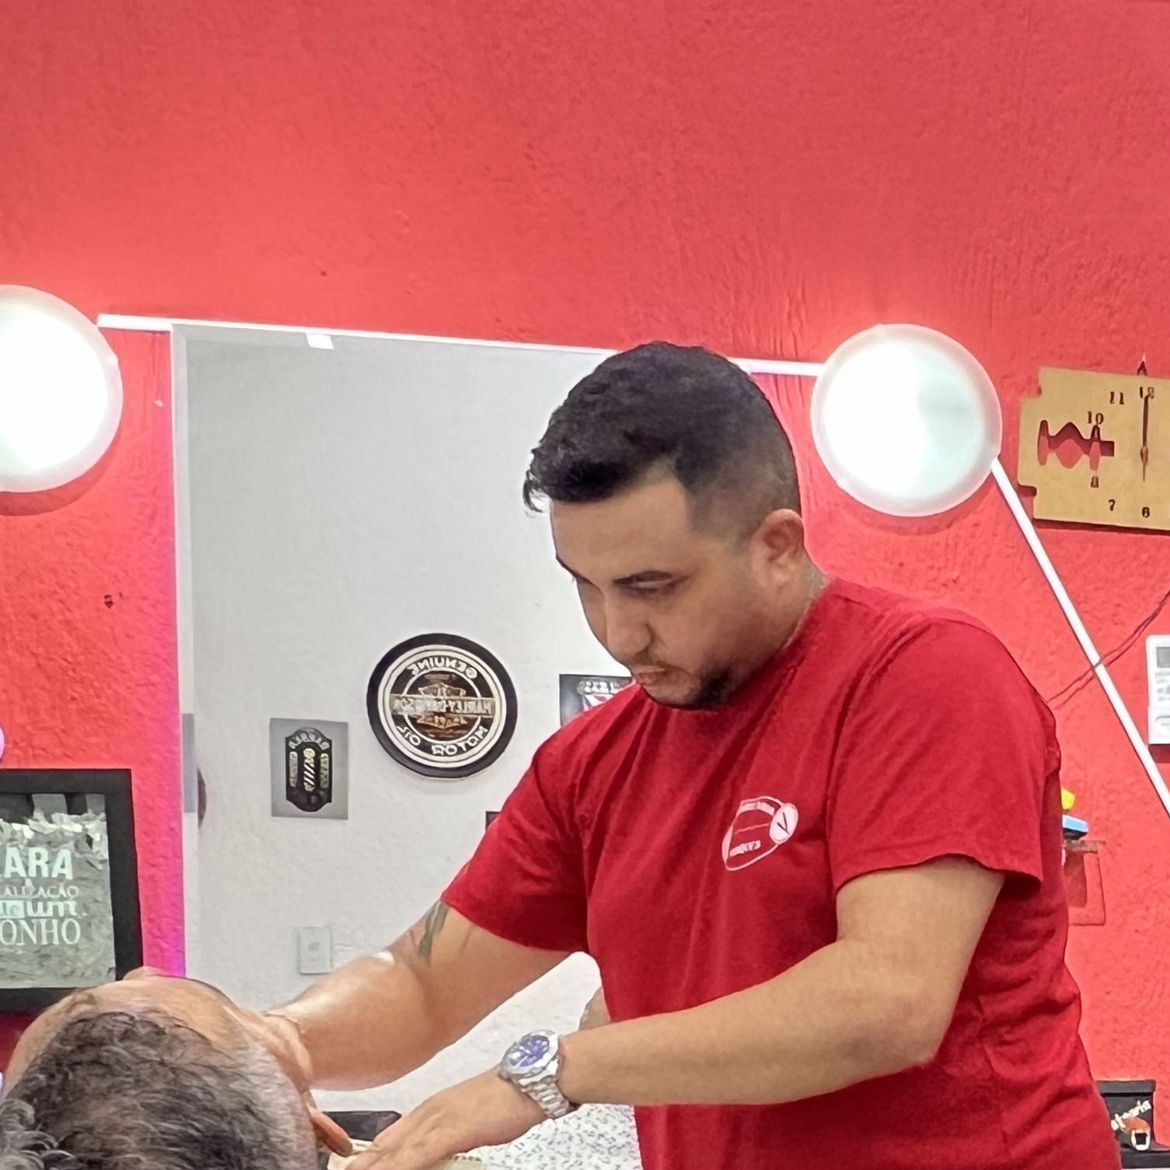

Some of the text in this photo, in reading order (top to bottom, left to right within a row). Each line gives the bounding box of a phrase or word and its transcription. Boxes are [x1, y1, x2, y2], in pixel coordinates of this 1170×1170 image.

[1109, 391, 1125, 405] 11
[1087, 411, 1104, 425] 10
[1108, 499, 1116, 512] 7
[1141, 506, 1151, 518] 6
